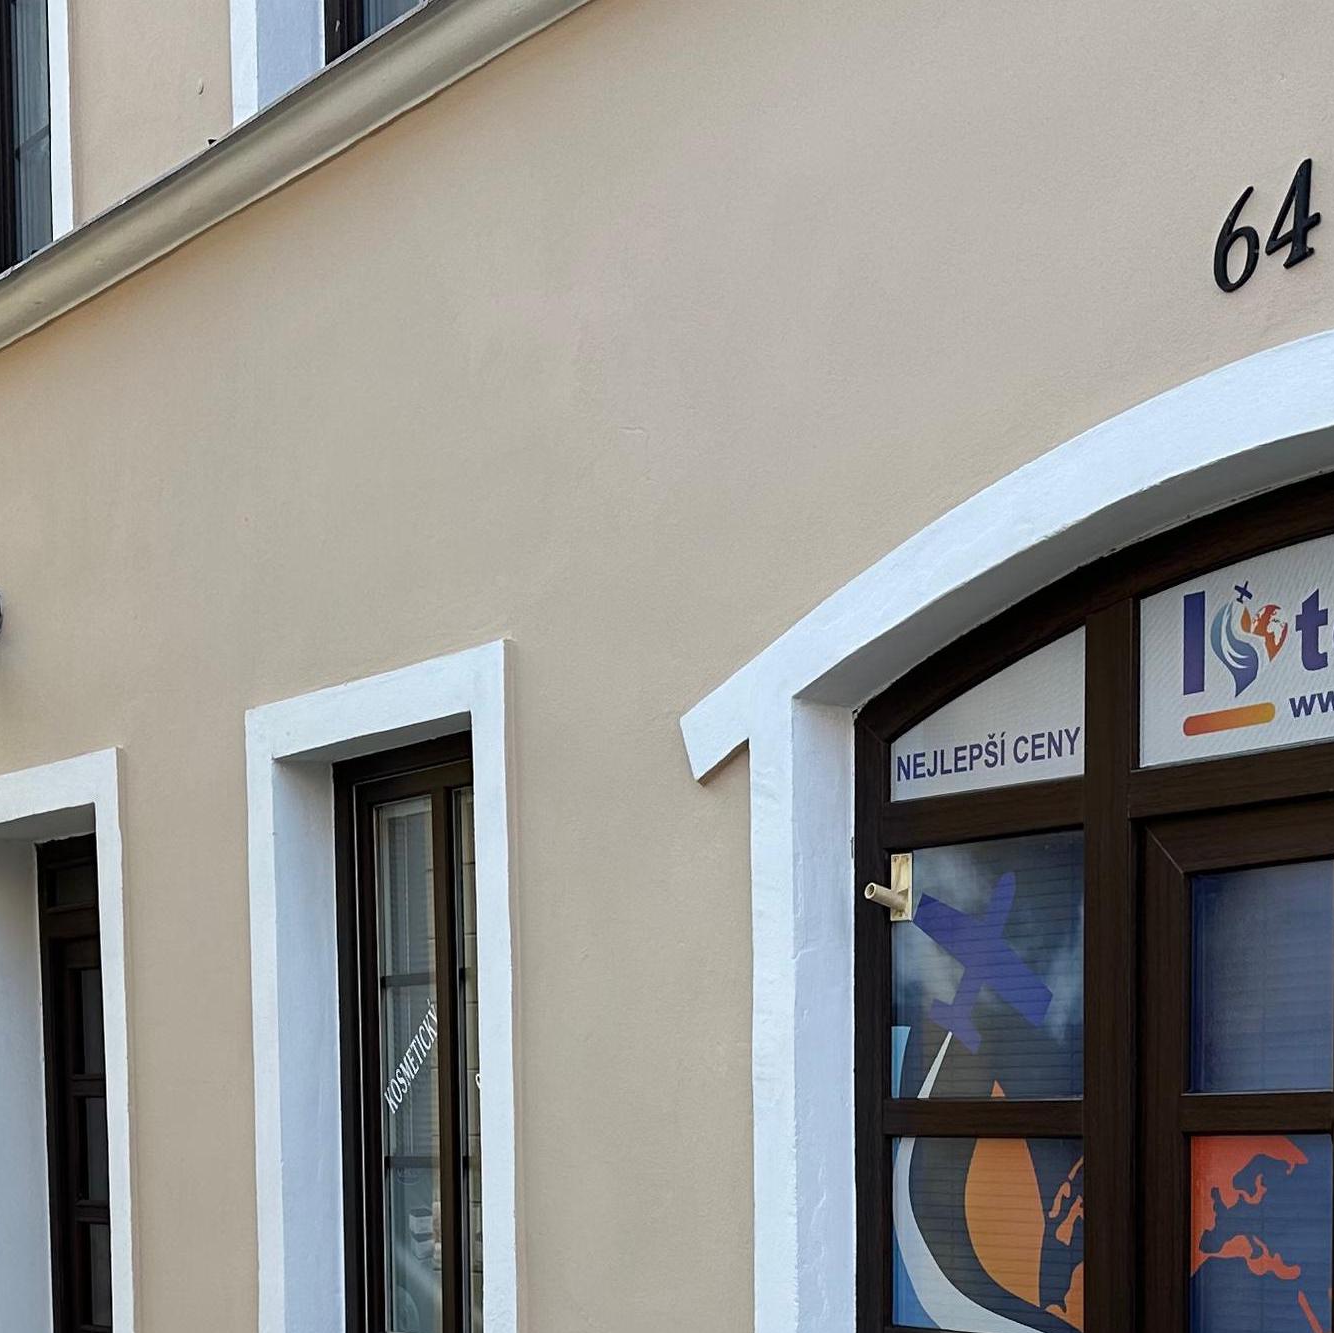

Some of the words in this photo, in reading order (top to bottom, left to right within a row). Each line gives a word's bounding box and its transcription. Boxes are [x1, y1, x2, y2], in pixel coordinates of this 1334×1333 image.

[1213, 158, 1322, 292] 64
[896, 731, 1006, 782] NEJLEPŠÍ
[1013, 726, 1081, 764] CENY
